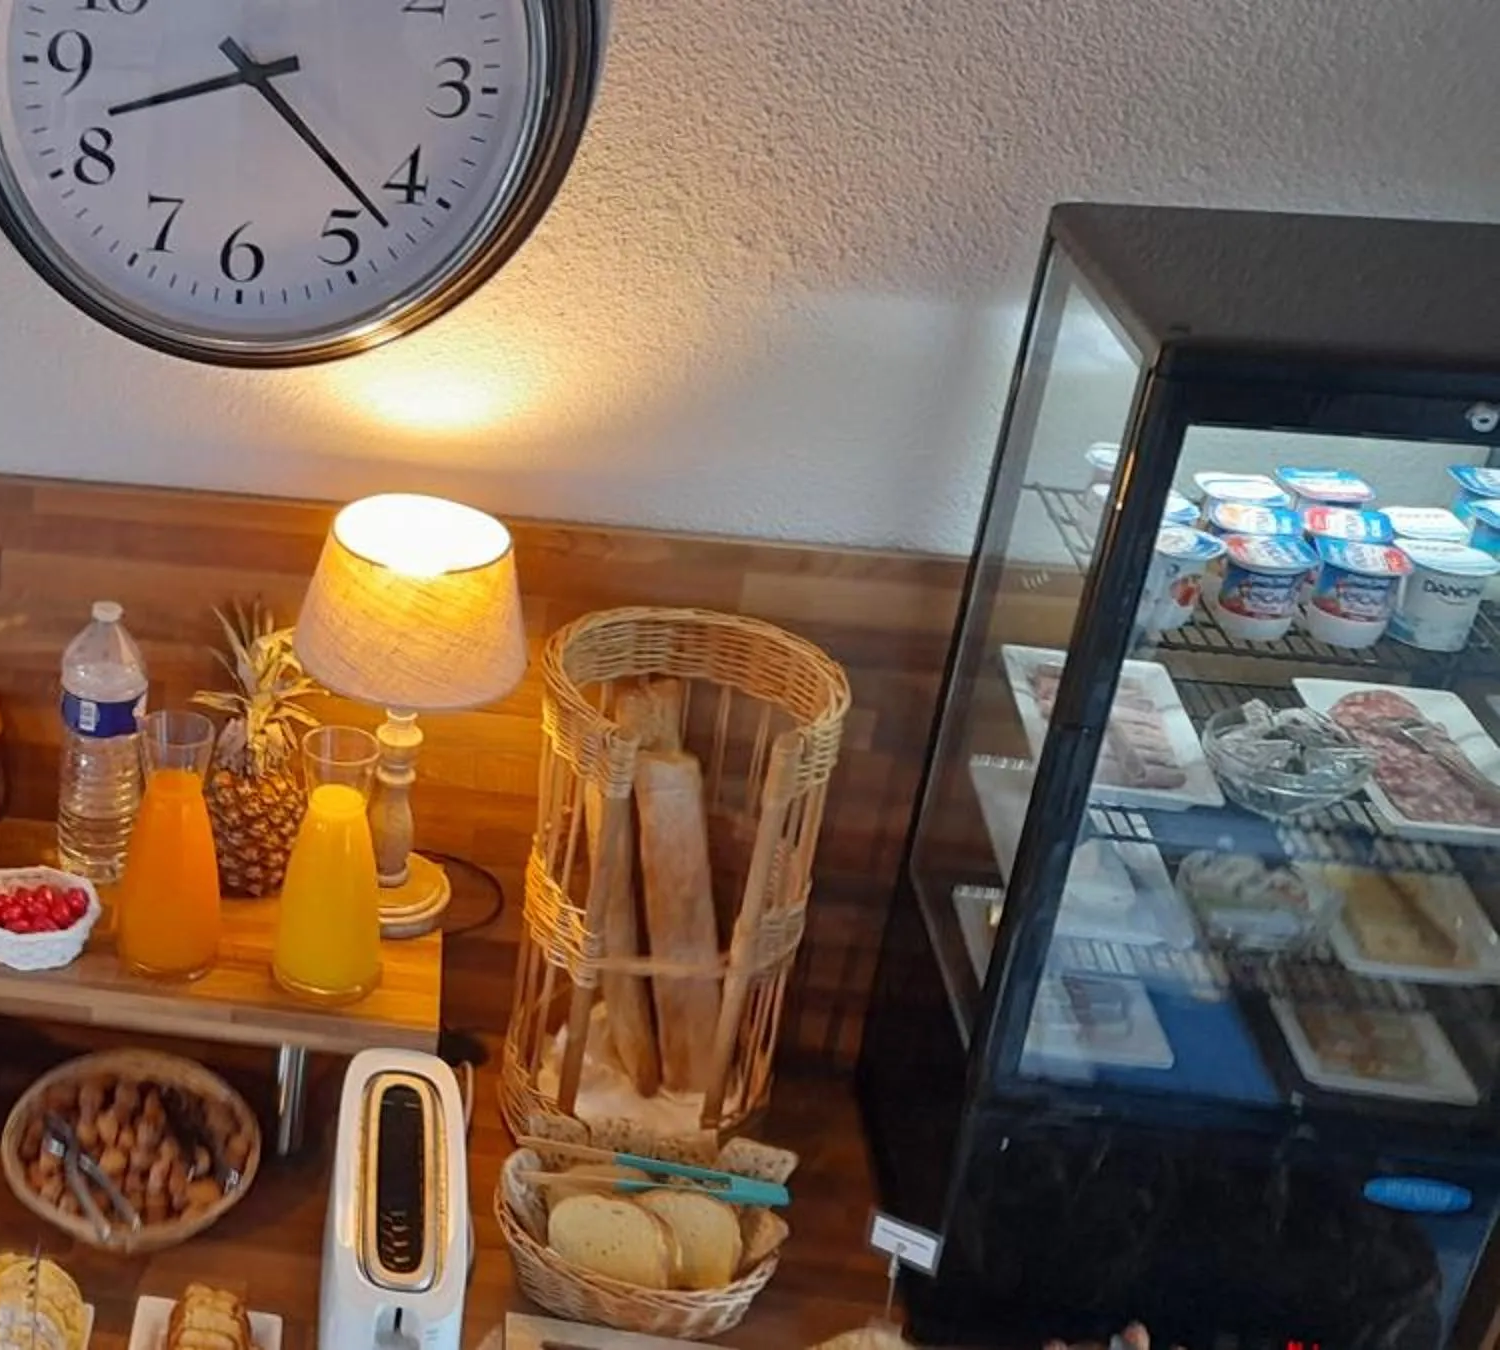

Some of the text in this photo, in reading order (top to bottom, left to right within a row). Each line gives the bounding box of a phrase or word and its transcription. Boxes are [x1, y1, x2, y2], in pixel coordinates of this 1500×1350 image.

[46, 29, 94, 96] 9
[426, 56, 472, 119] 3
[72, 126, 116, 186] 8
[382, 144, 429, 206] 4
[146, 193, 185, 254] 7
[219, 222, 265, 283] 6
[318, 208, 362, 267] 5
